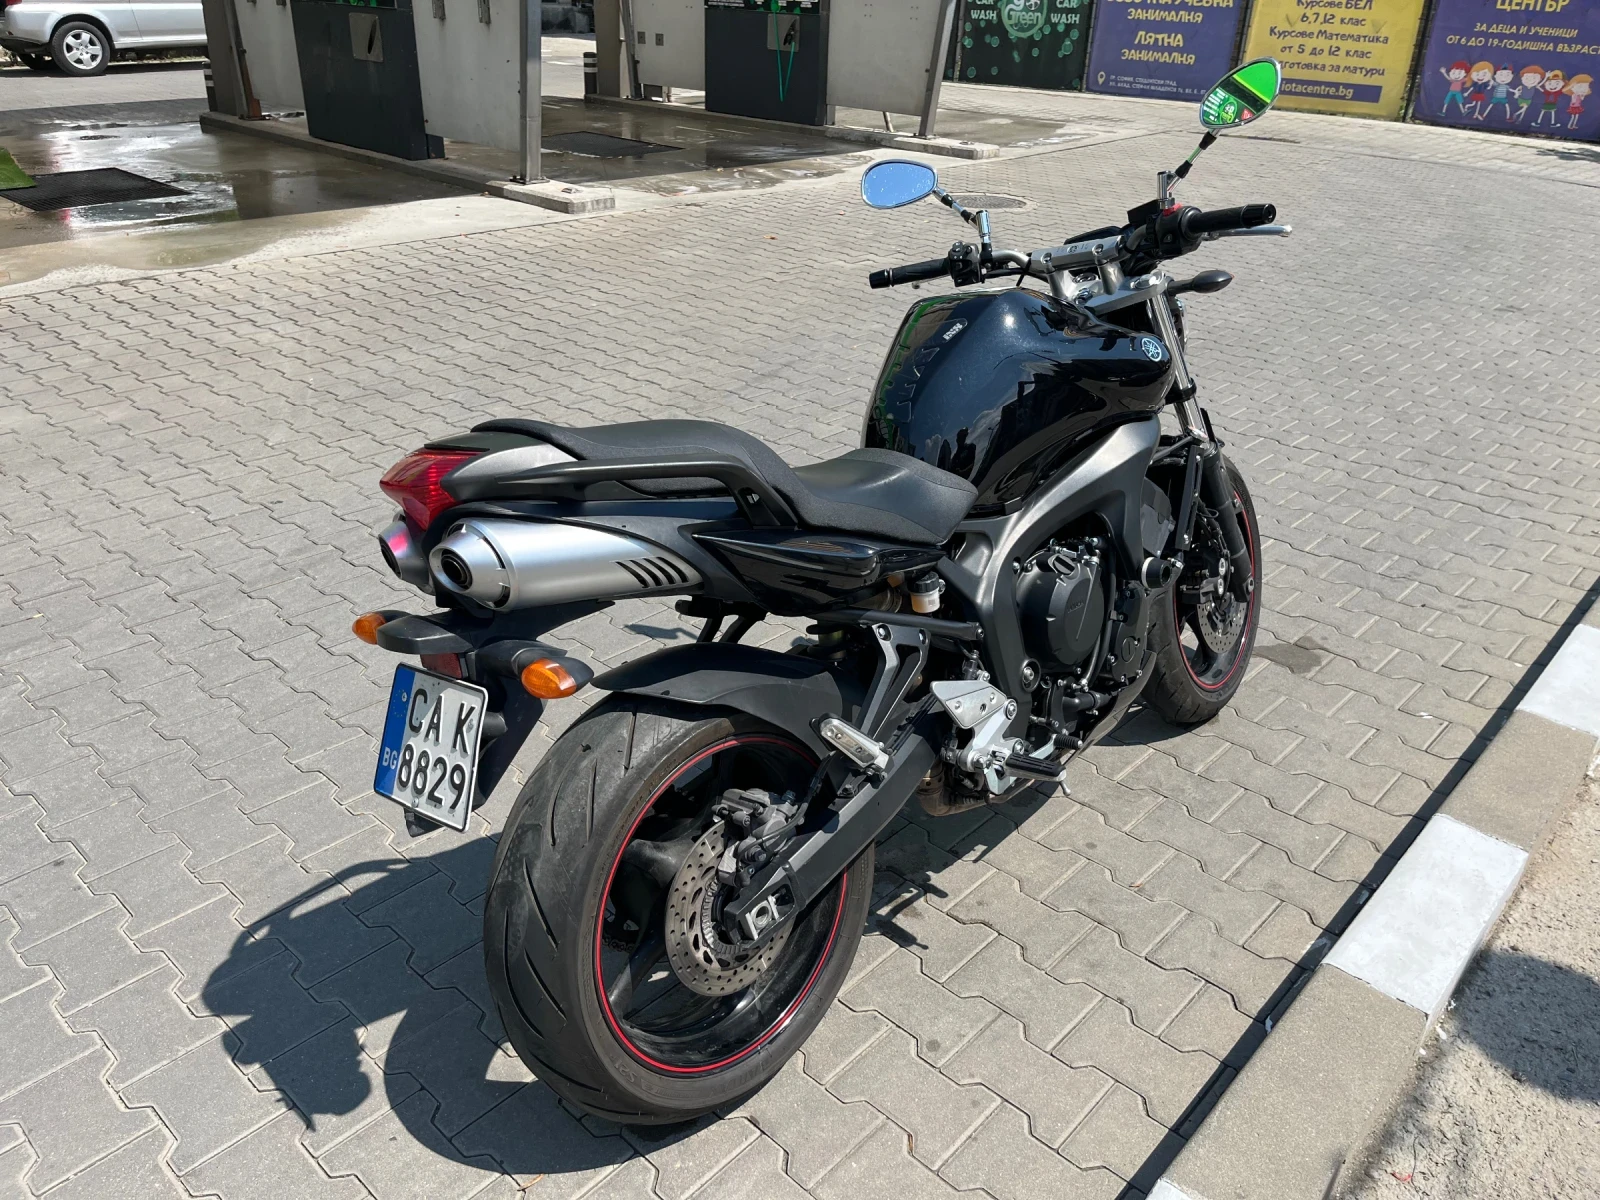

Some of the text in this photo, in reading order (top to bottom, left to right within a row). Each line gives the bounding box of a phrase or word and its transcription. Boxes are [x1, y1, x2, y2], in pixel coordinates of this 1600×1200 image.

[1056, 0, 1078, 9] CAR
[1345, 0, 1373, 11] БЕЛ
[970, 9, 997, 20] WASH
[1050, 13, 1080, 24] WASH
[1127, 8, 1203, 23] ЗАНИМАЛНЯ
[1340, 16, 1367, 27] клас
[1134, 30, 1184, 48] ЛЯТНА
[1269, 25, 1390, 45] Курсове Математика
[1474, 22, 1579, 39] ЗА ДЕЦА И УЧЕНИЦИ
[1280, 45, 1294, 54] от
[1296, 43, 1306, 55] 5
[1308, 46, 1325, 57] до
[1345, 49, 1373, 60] клас
[1446, 35, 1460, 45] ОТ
[1460, 36, 1467, 45] 6
[1467, 37, 1485, 47] ДО
[1487, 38, 1554, 52] 19-ГОДИШНА
[1120, 48, 1196, 65] ЗАНИМАЛНЯ
[1278, 60, 1386, 79] дготовка за матури
[1281, 81, 1354, 99] iotacentre.bg
[453, 701, 477, 755] K
[382, 747, 398, 769] BG
[398, 743, 466, 811] 8829
